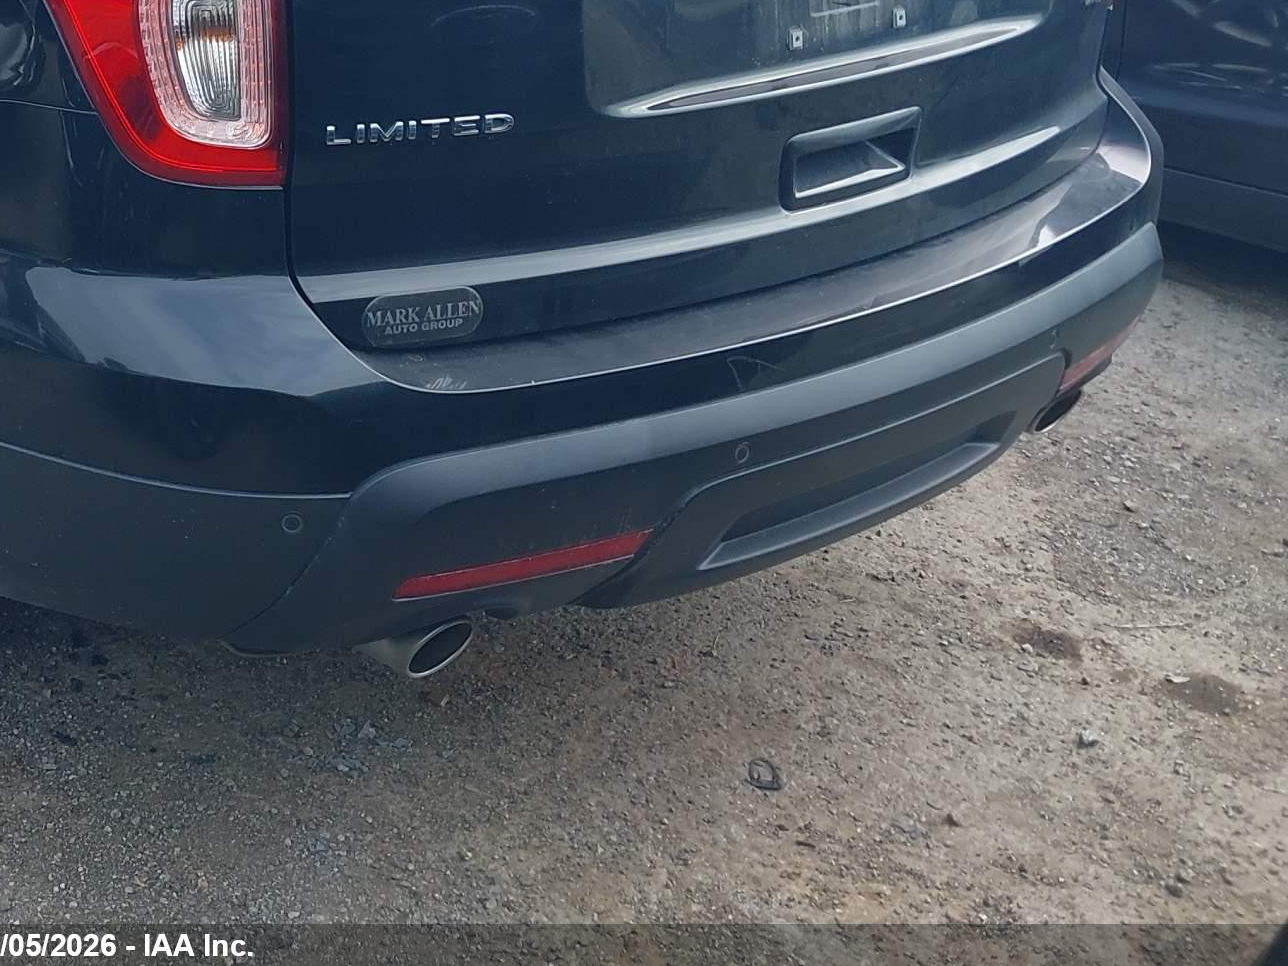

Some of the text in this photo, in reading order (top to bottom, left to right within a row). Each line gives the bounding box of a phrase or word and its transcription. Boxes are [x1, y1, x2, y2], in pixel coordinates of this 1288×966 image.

[326, 113, 515, 146] LIMITED
[366, 300, 479, 327] MARK ALLEN
[384, 318, 463, 336] AUTO GROUP
